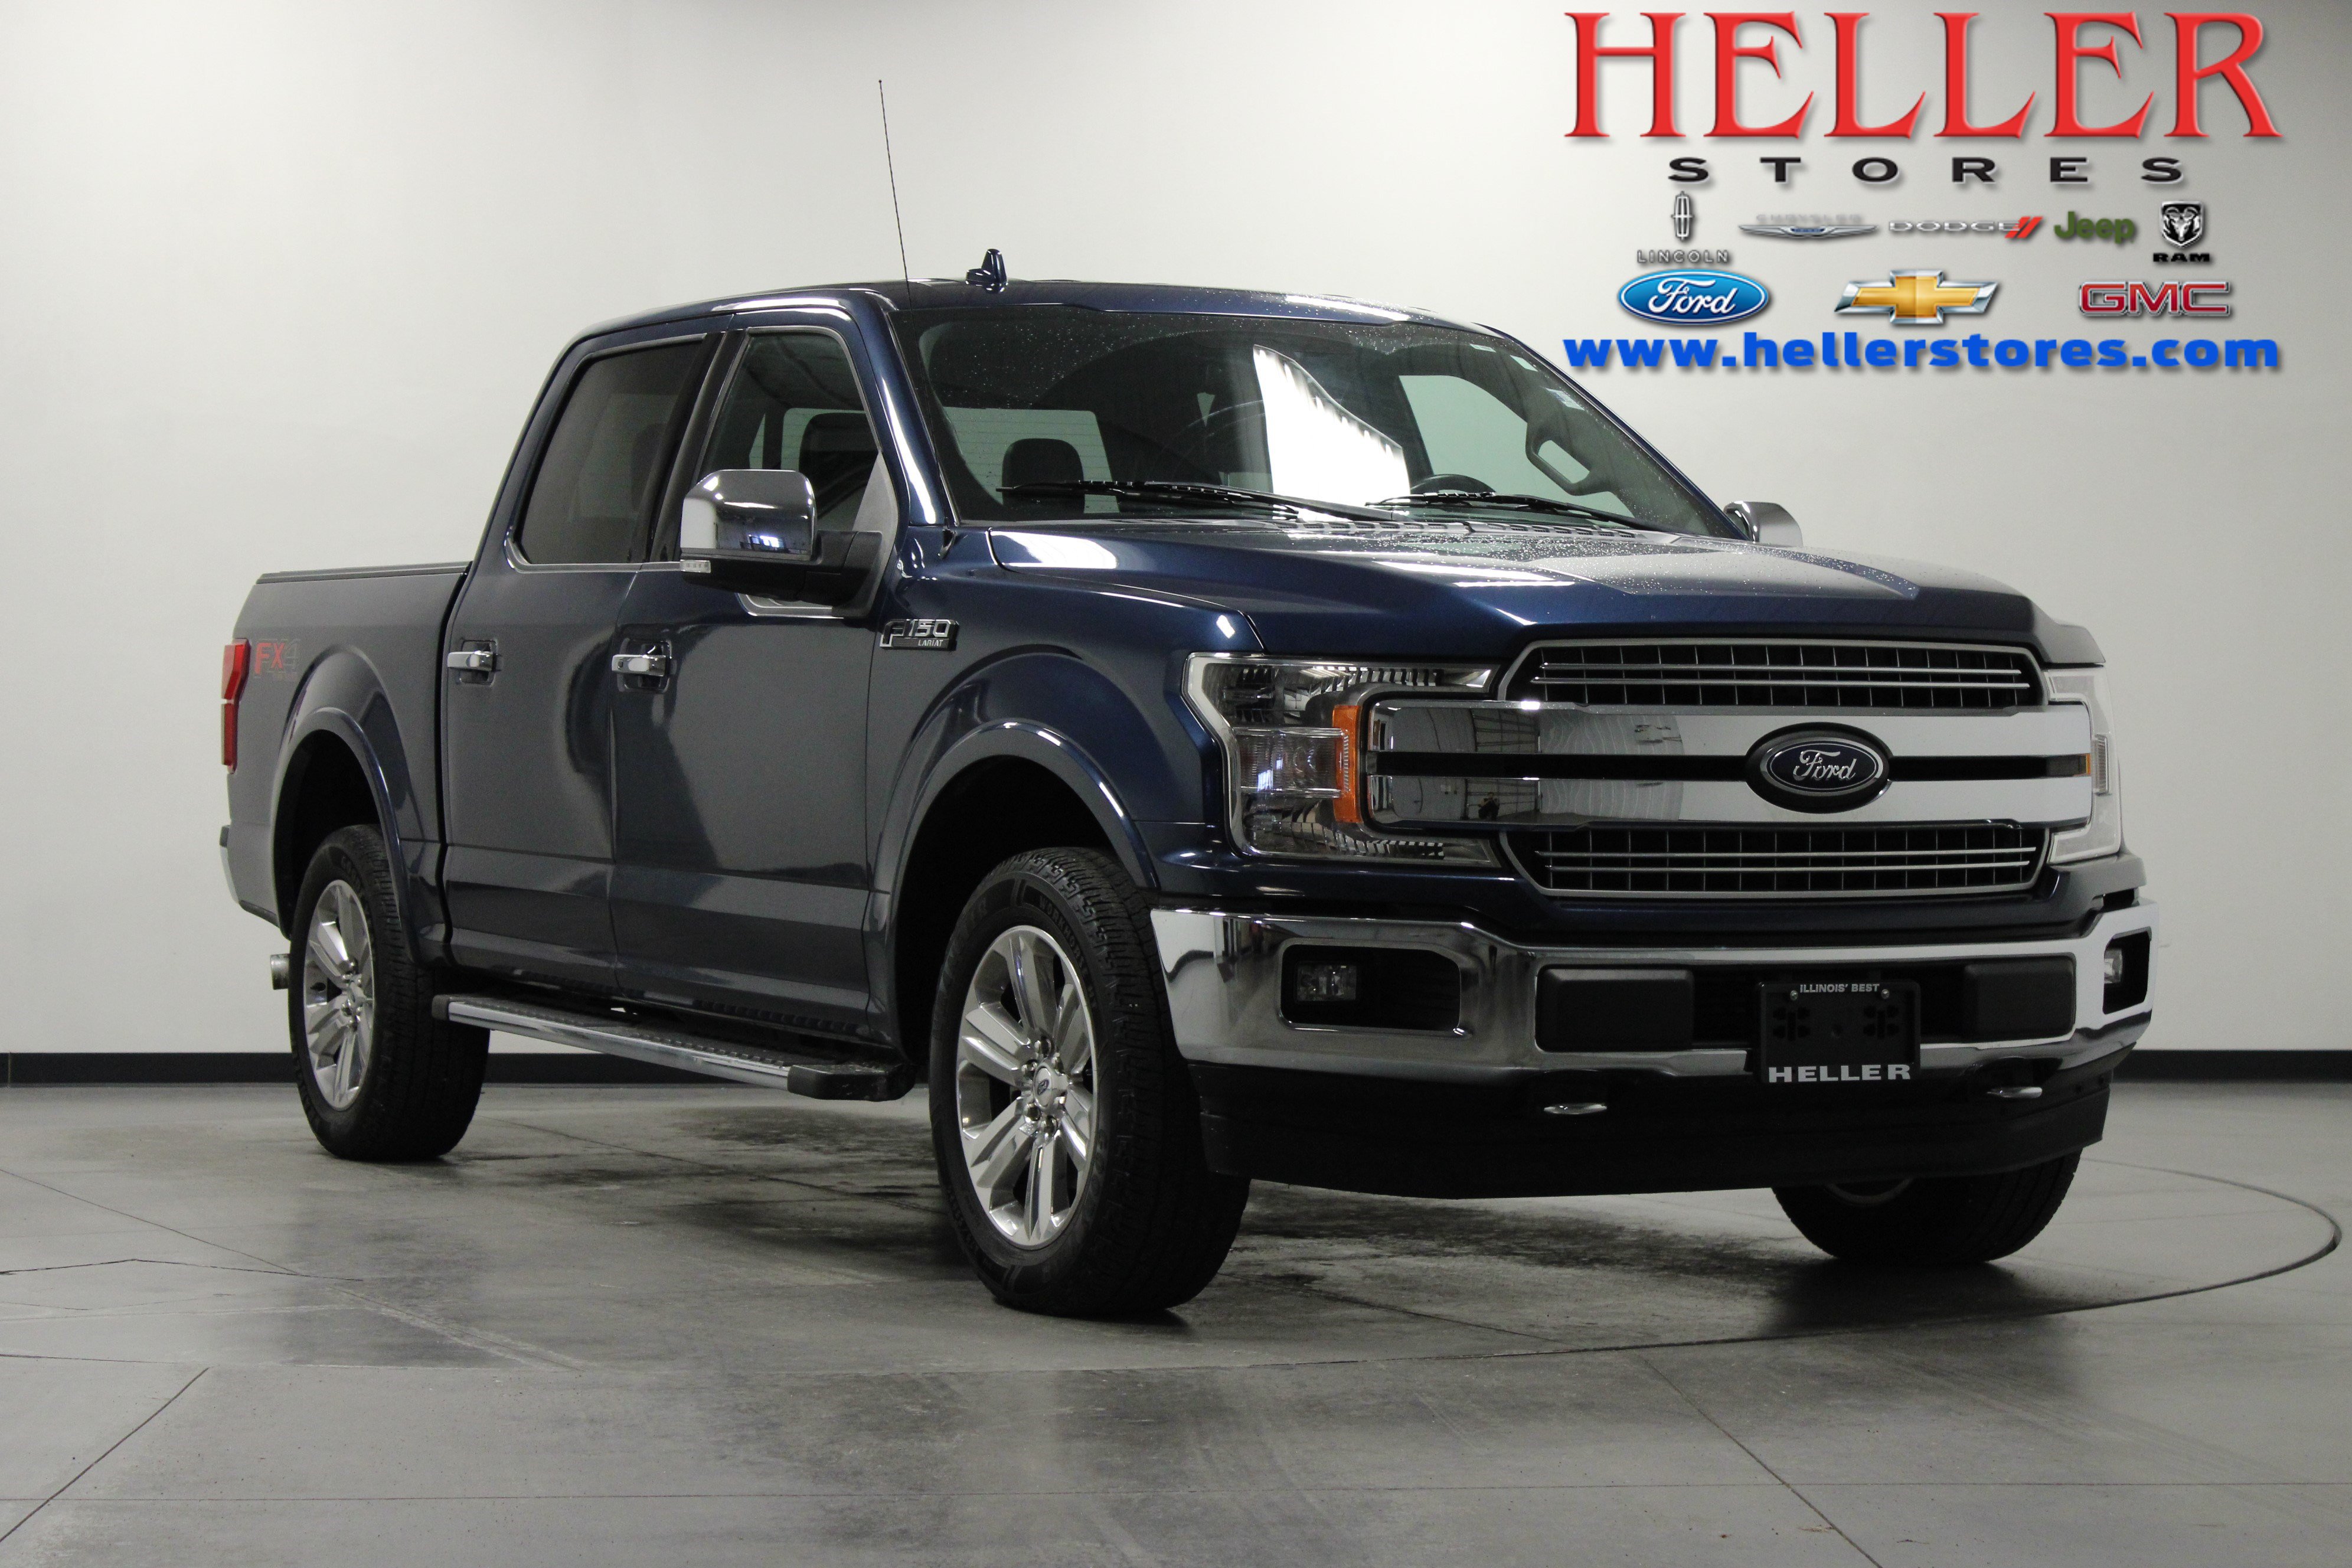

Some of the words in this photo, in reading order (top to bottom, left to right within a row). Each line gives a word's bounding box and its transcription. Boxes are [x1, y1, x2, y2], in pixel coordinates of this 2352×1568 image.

[1793, 750, 1857, 781] Ford
[1851, 984, 1880, 992] BEST
[1769, 1064, 1910, 1083] HELLER
